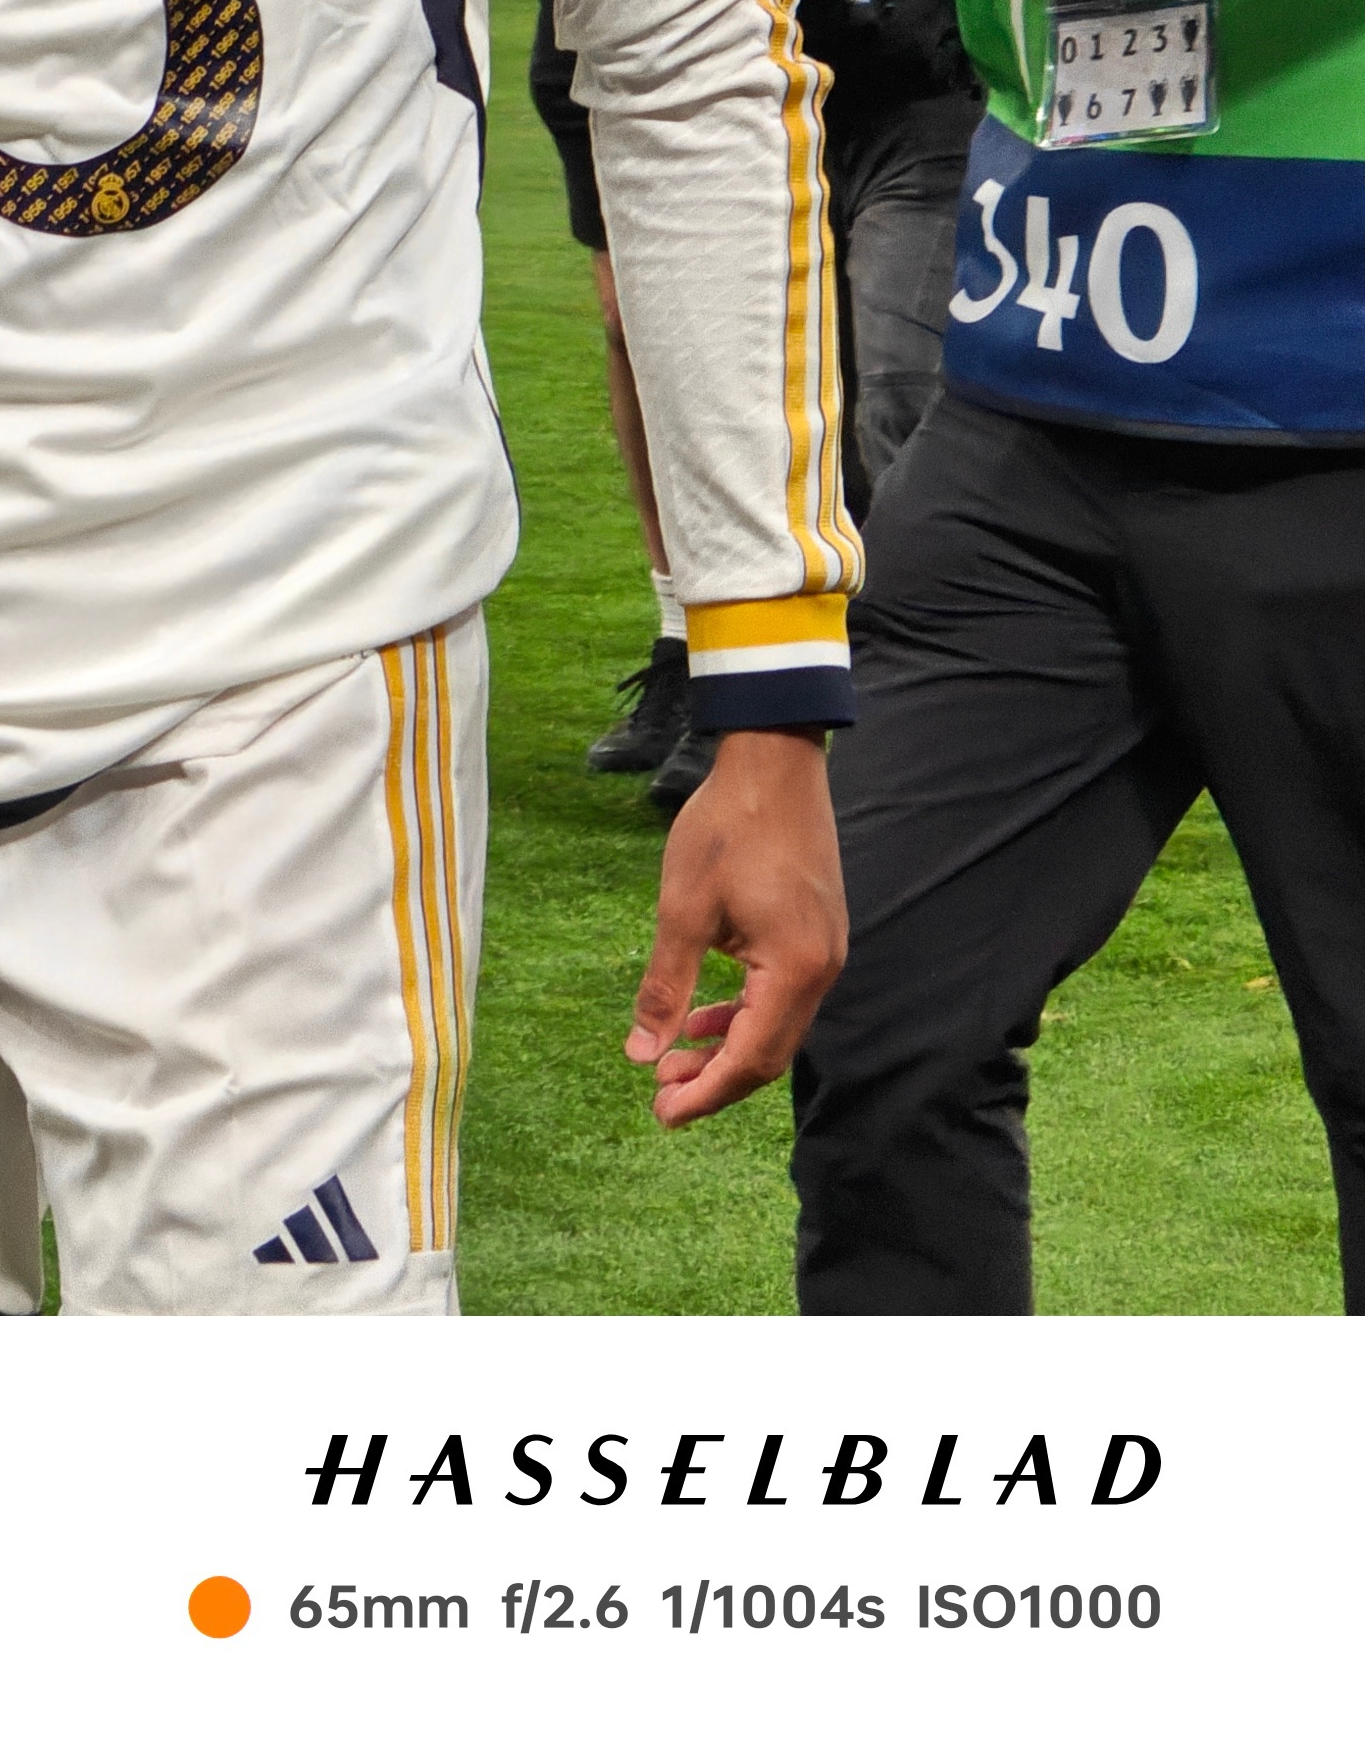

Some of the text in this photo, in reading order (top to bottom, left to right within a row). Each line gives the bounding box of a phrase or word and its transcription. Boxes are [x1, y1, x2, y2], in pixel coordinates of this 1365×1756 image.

[1060, 24, 1169, 64] 0 1 2 3
[1086, 89, 1137, 120] 6 7
